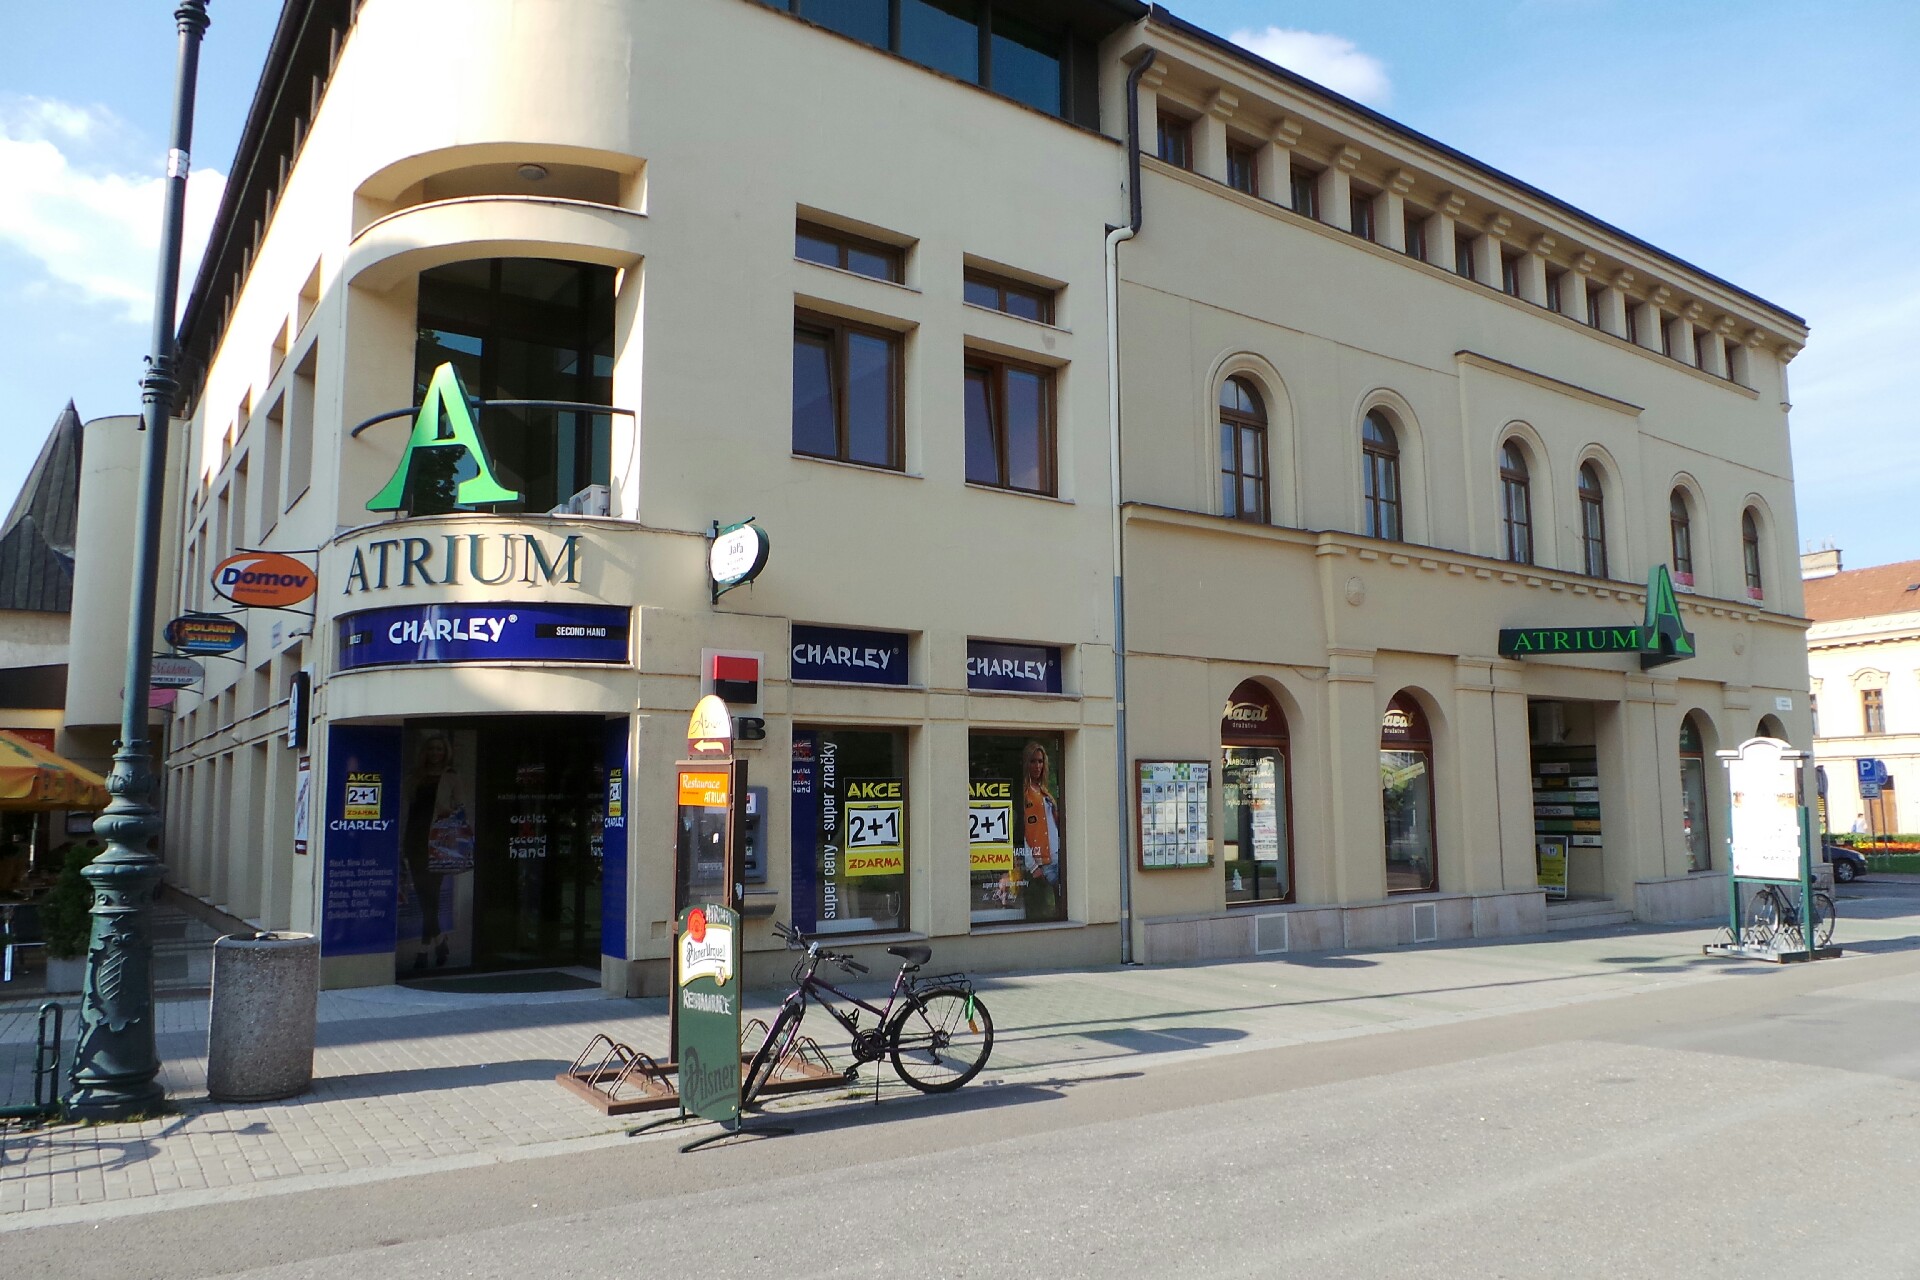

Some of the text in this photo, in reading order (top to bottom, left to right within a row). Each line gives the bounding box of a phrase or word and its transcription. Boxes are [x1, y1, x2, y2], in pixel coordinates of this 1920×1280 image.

[343, 534, 583, 595] ATRIUM
[222, 567, 308, 588] Domov
[187, 633, 232, 643] STUDIO
[388, 617, 506, 644] CHARLEY
[556, 626, 606, 637] SECOND HAND
[1513, 629, 1639, 650] ATRIUM
[793, 643, 891, 671] CHARLEY
[967, 657, 1047, 681] CHARLEY
[1383, 709, 1415, 728] arat
[820, 741, 838, 789] značky
[1860, 760, 1872, 776] P
[348, 773, 381, 782] AKCE
[682, 774, 720, 790] Restaurace
[349, 789, 377, 803] 2+1
[704, 791, 726, 804] ATRIUM
[847, 782, 902, 799] AKCE
[510, 813, 548, 824] outlet
[823, 793, 838, 830] super
[329, 819, 390, 831] CHARLEY
[850, 811, 897, 843] 2+1
[970, 811, 1007, 839] 2+1
[509, 834, 547, 846] second
[509, 845, 547, 859] hand
[824, 845, 838, 876] ceny
[970, 854, 1011, 864] DARMA
[848, 857, 902, 869] ZDARMA
[825, 880, 838, 919] super
[684, 1046, 736, 1112] Pilsner
